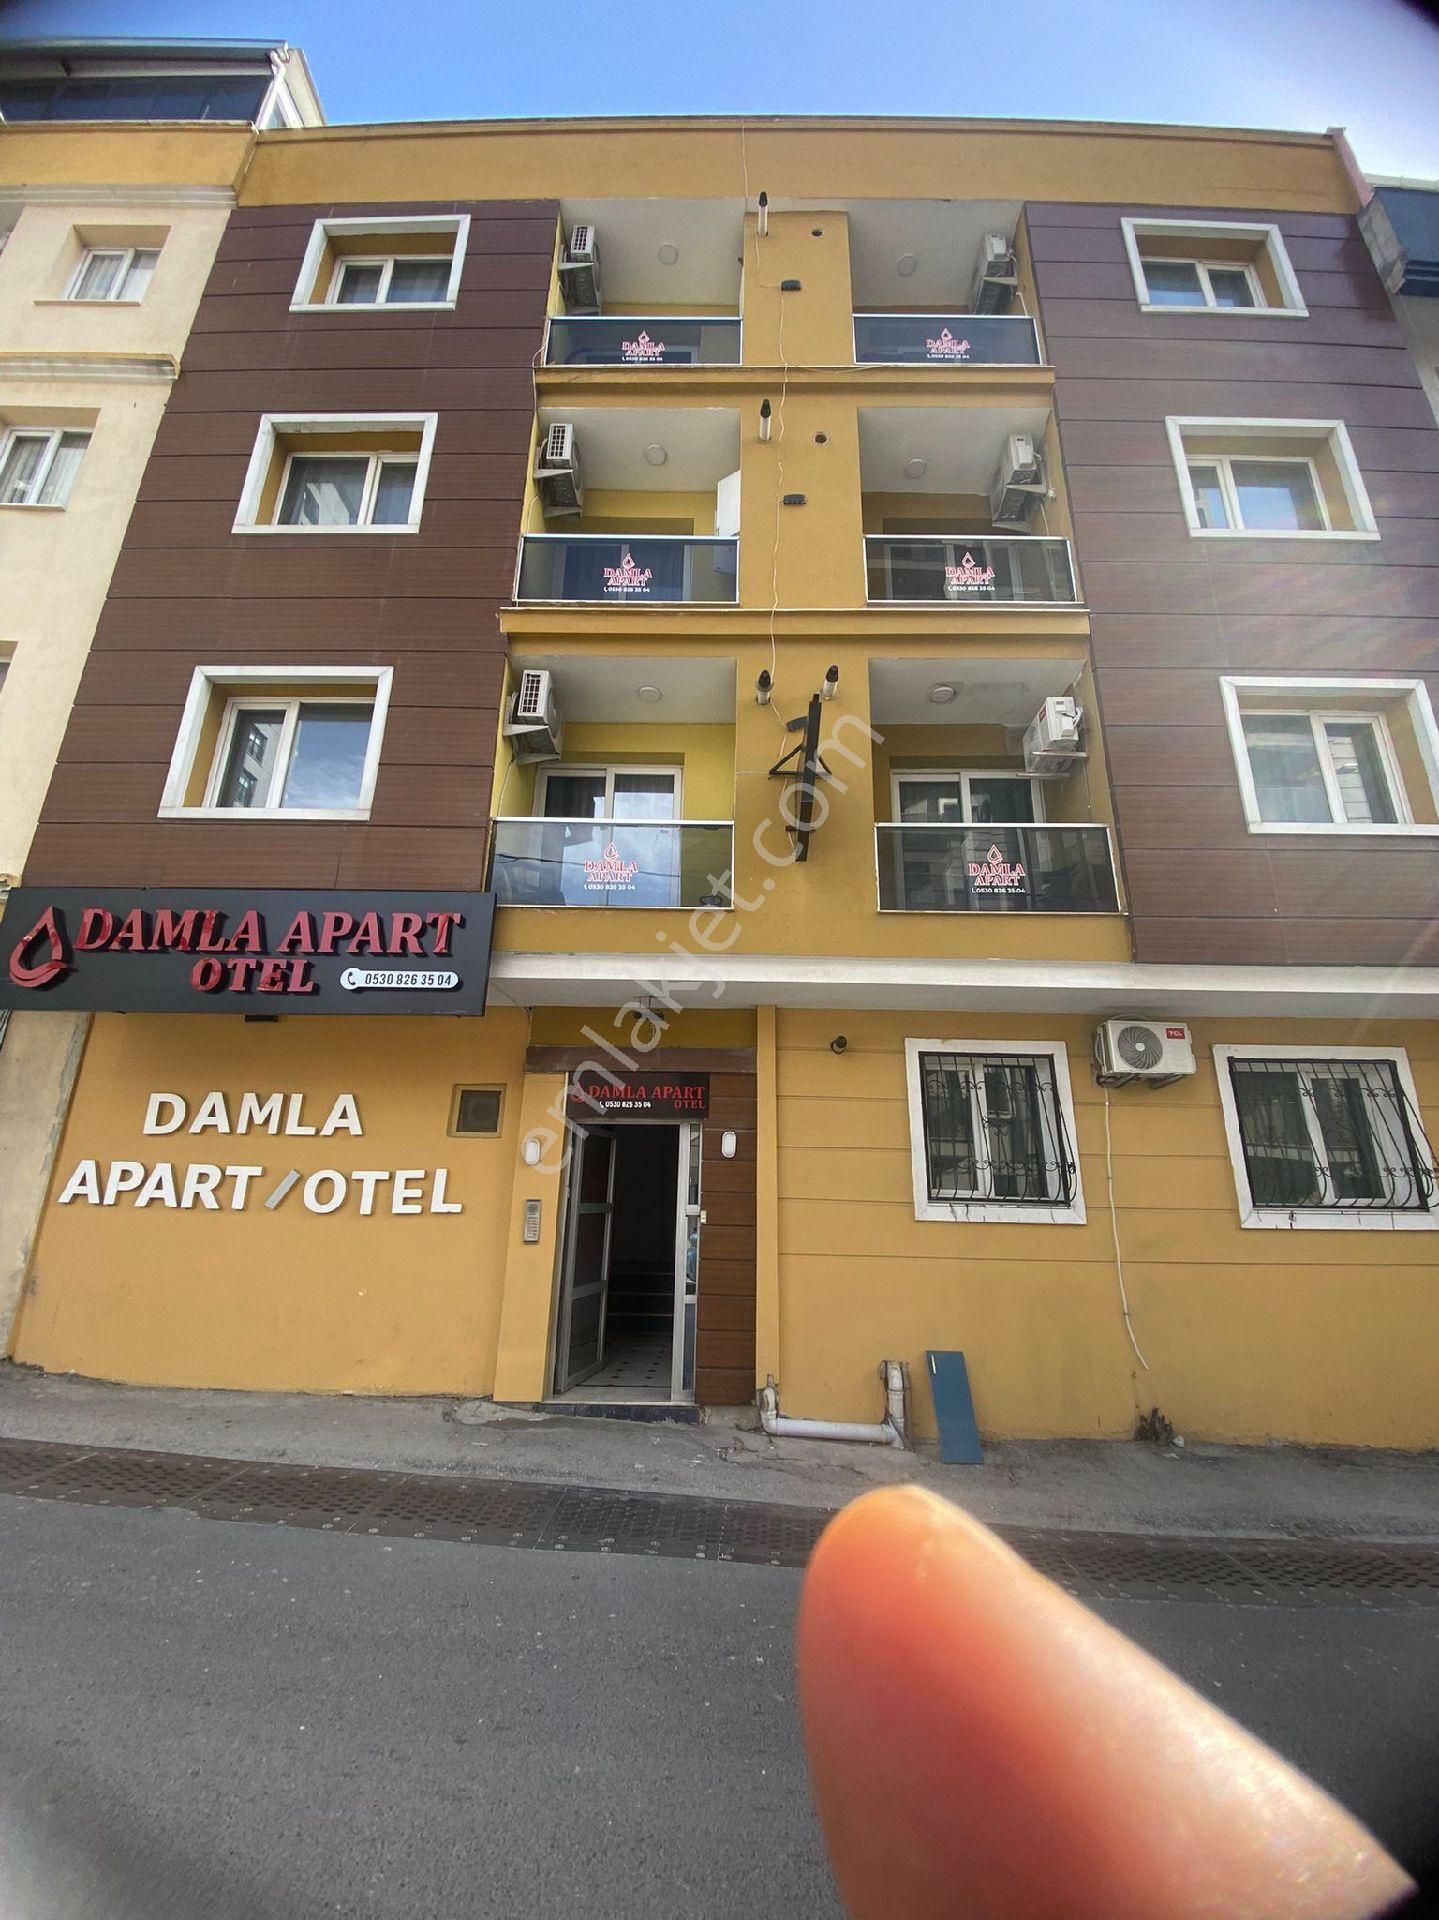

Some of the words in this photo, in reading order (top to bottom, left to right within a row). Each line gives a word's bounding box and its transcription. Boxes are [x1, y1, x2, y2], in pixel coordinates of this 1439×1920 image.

[603, 567, 653, 578] DAMLA
[945, 566, 996, 577] DAMLA
[584, 860, 639, 873] DAMLA
[968, 862, 1026, 877] DAMLA
[587, 872, 633, 882] APART
[974, 875, 1021, 886] APART
[73, 907, 262, 953] DAMLA
[278, 910, 463, 955] APART
[189, 956, 315, 993] OTEL
[364, 973, 394, 985] 0530
[396, 973, 418, 986] 826
[420, 974, 435, 986] 35
[437, 974, 452, 986] 04
[588, 1085, 647, 1099] DAMLA
[651, 1086, 706, 1100] APART
[674, 1100, 706, 1110] OTEL
[142, 1091, 364, 1136] DAMLA
